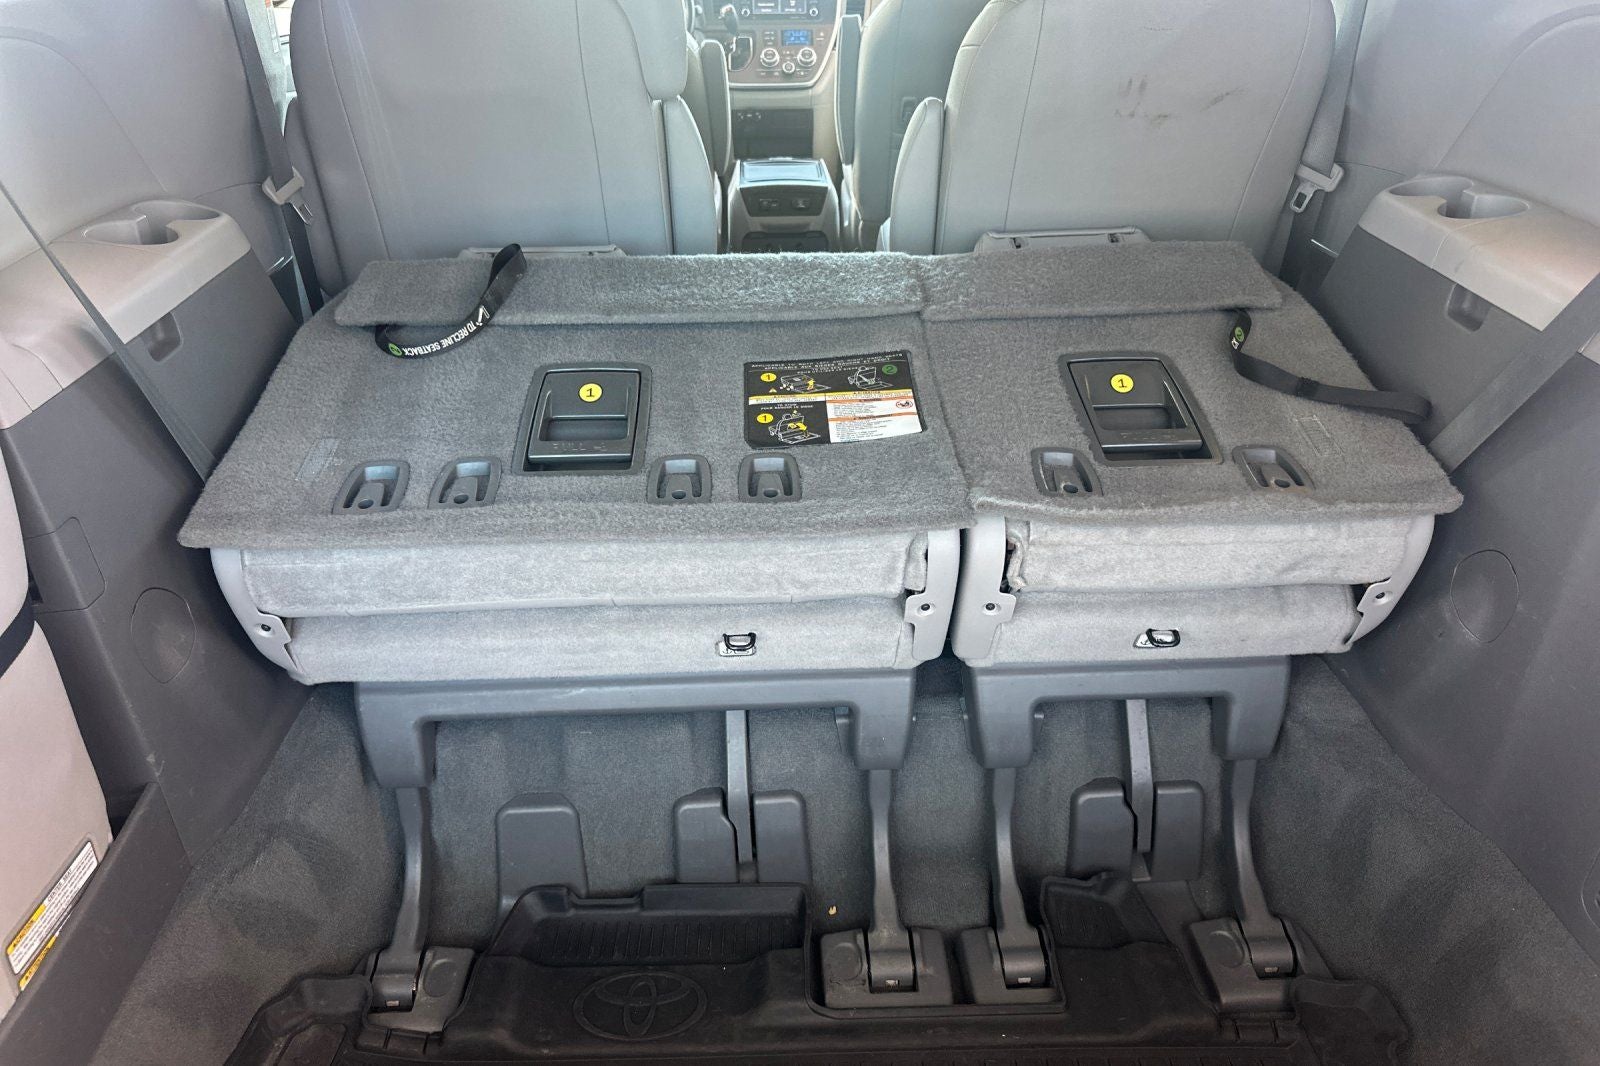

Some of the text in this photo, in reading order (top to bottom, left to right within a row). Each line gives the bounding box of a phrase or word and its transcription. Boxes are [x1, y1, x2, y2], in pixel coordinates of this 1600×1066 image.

[402, 321, 477, 356] TO RECLINE SEATBACK
[886, 365, 894, 373] 2
[1118, 378, 1128, 388] 1
[585, 387, 595, 398] 1
